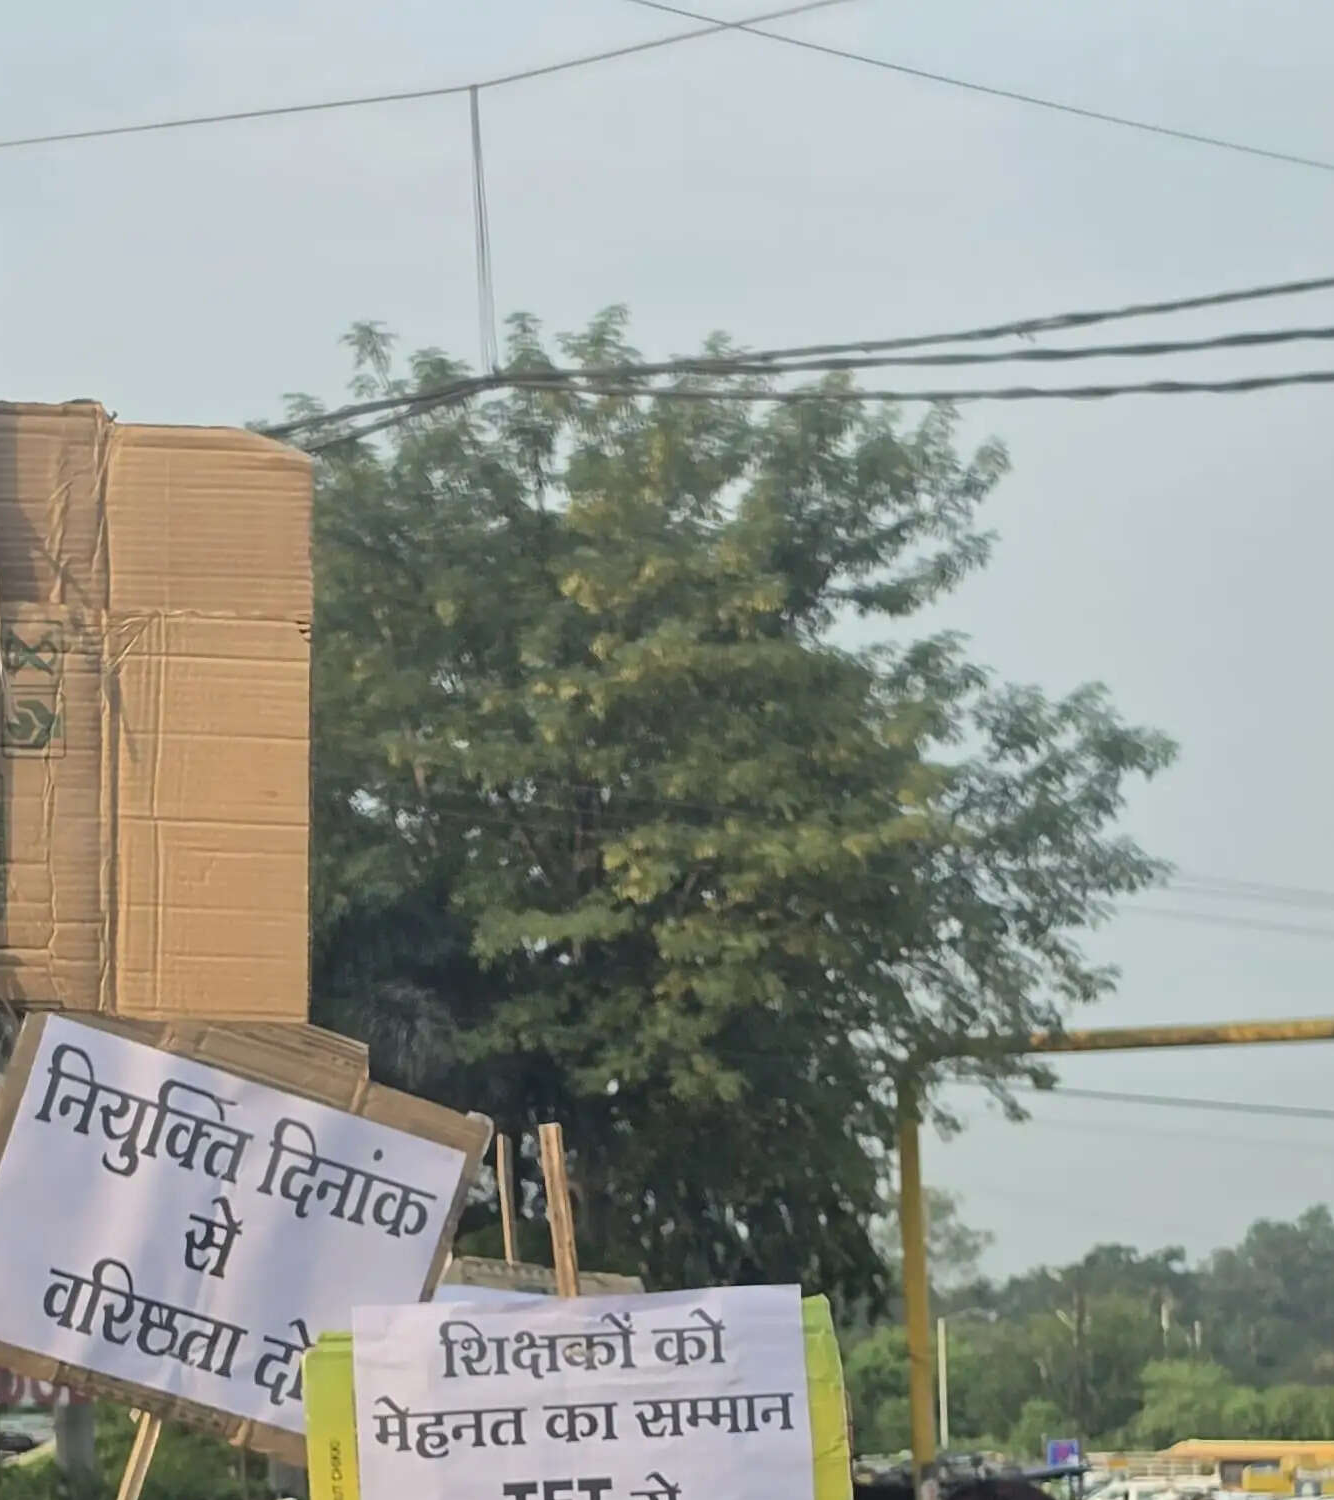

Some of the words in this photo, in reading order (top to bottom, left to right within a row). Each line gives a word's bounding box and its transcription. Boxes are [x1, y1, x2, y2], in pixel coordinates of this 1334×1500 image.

[34, 1042, 255, 1183] नियुक्ति
[258, 1118, 437, 1238] दिनांक
[184, 1197, 242, 1278] से
[43, 1258, 249, 1378] वरिष्ठता
[439, 1312, 636, 1379] शिक्षकों
[651, 1308, 726, 1367] को
[373, 1396, 528, 1458] मेहनत
[544, 1401, 619, 1443] का
[633, 1392, 795, 1439] सम्मान
